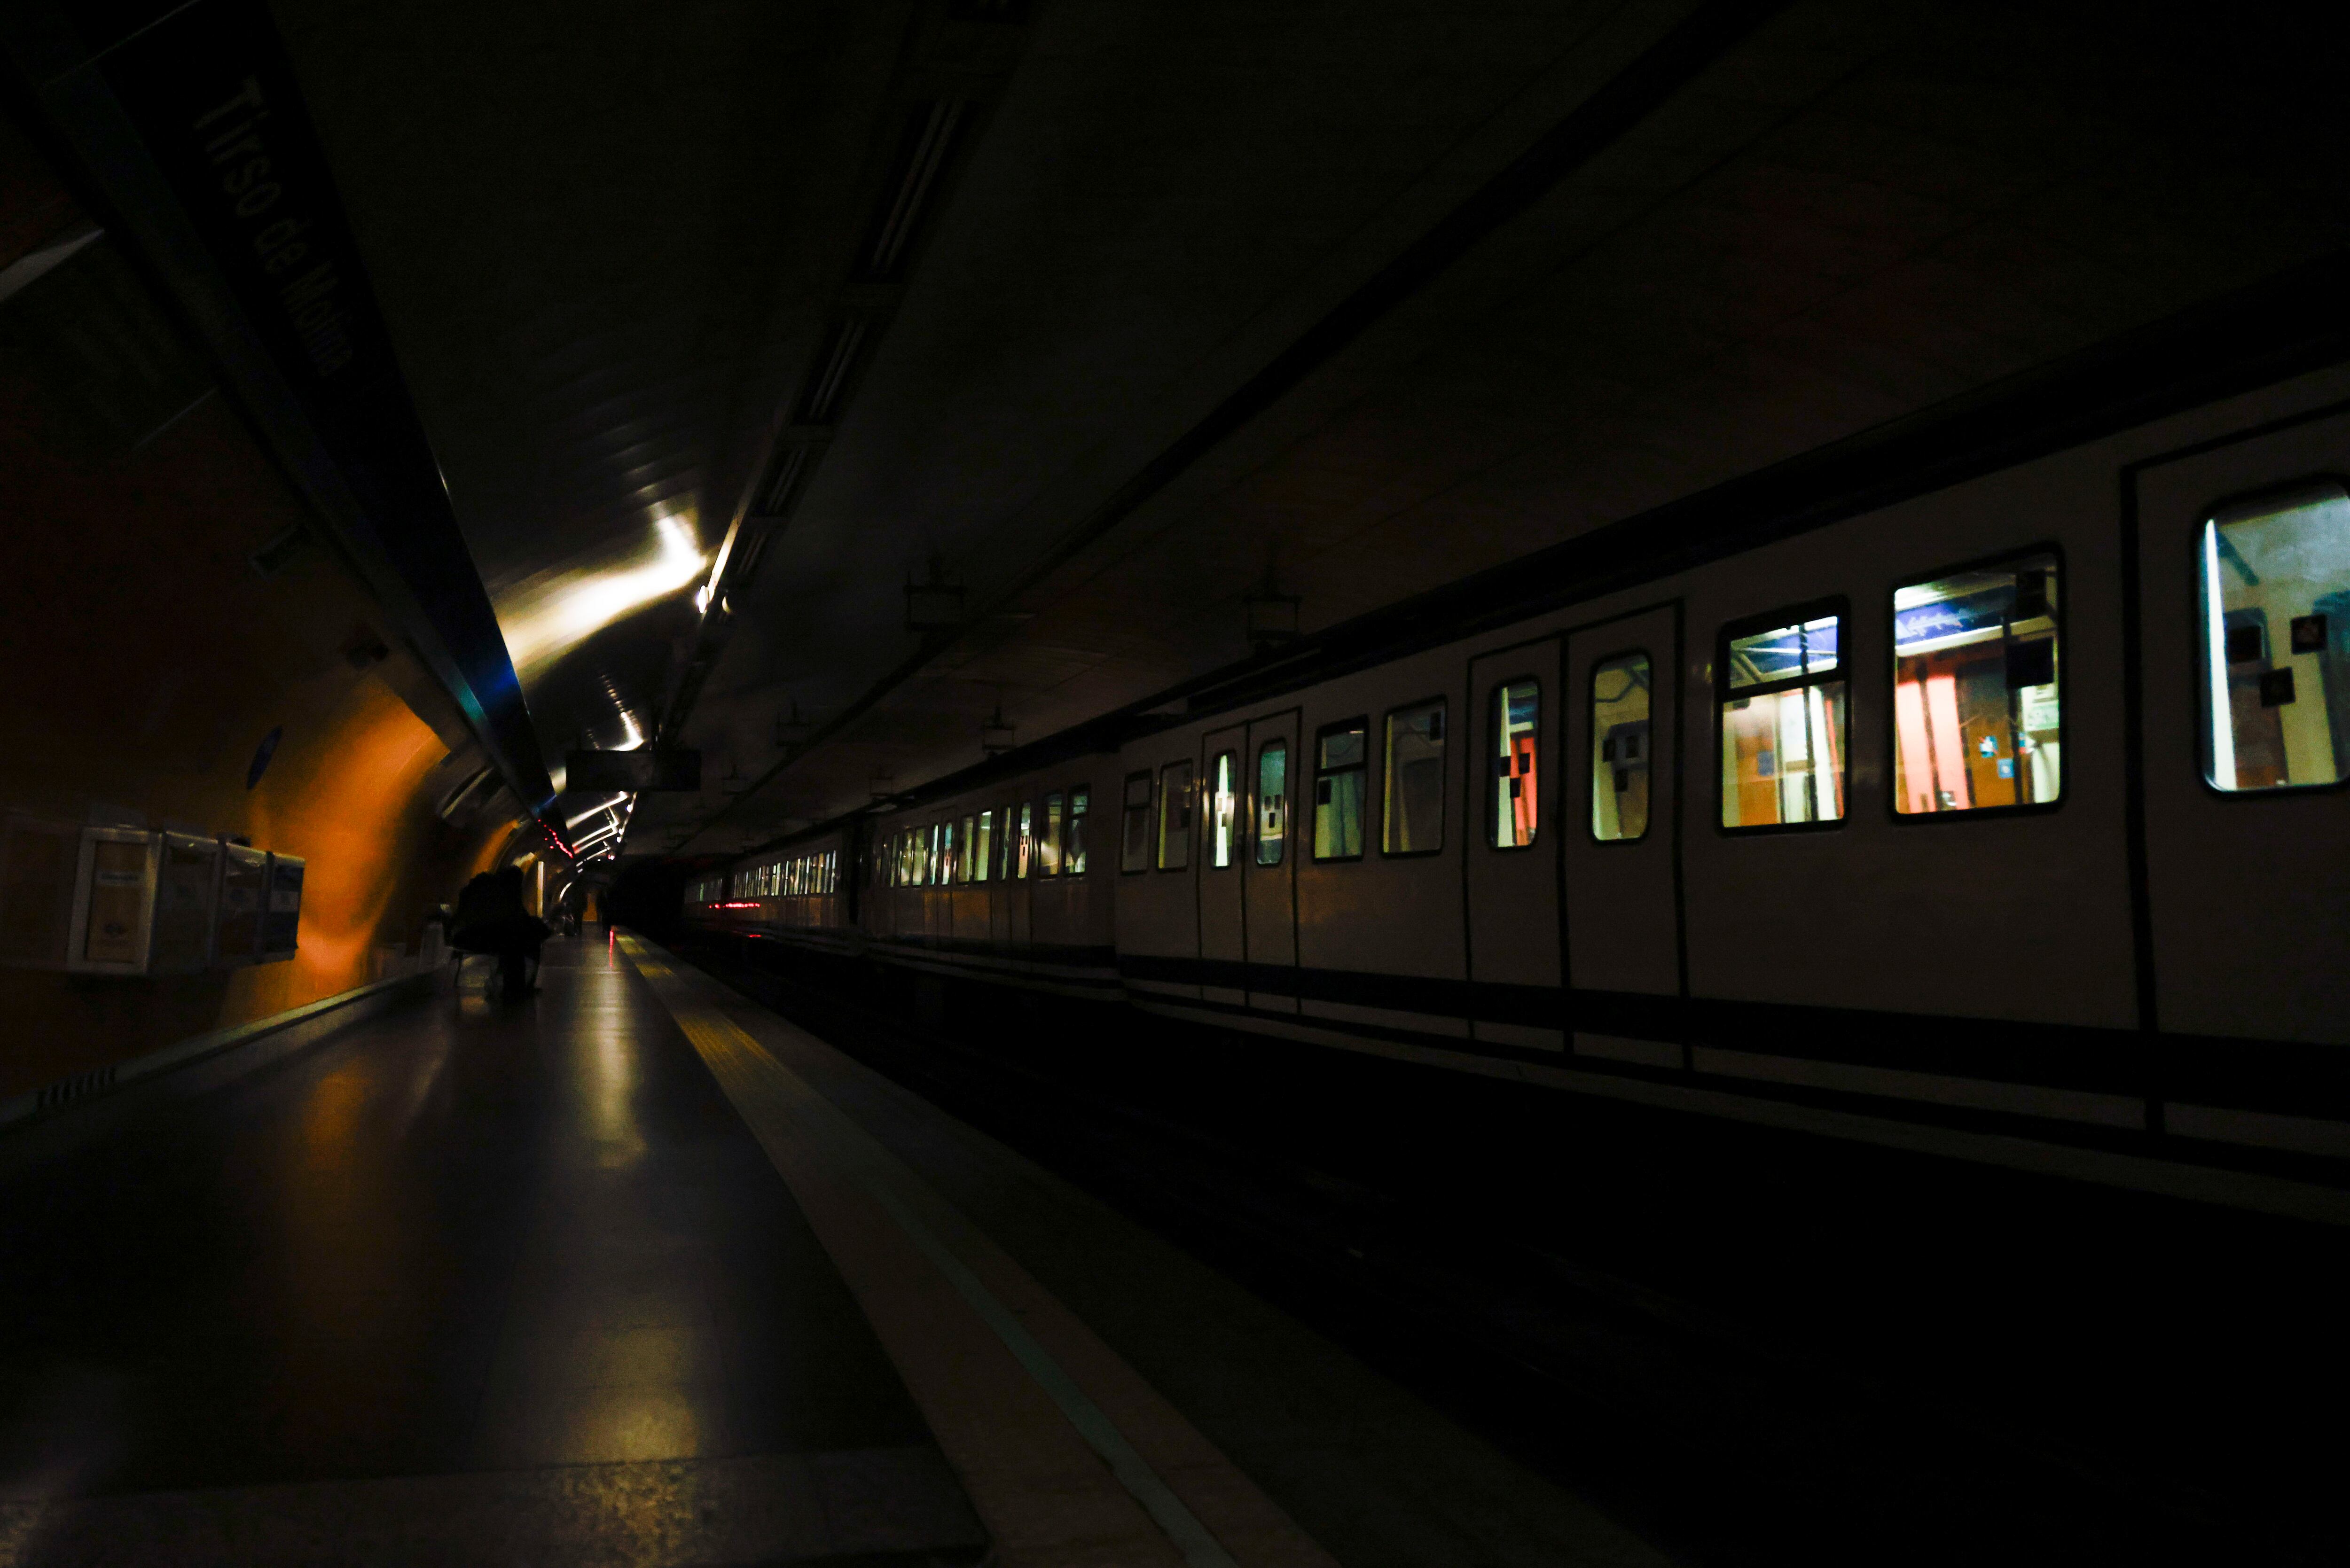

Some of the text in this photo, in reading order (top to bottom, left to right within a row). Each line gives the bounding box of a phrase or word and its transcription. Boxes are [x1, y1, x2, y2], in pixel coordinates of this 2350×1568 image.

[192, 74, 354, 378] Tirso de Molina
